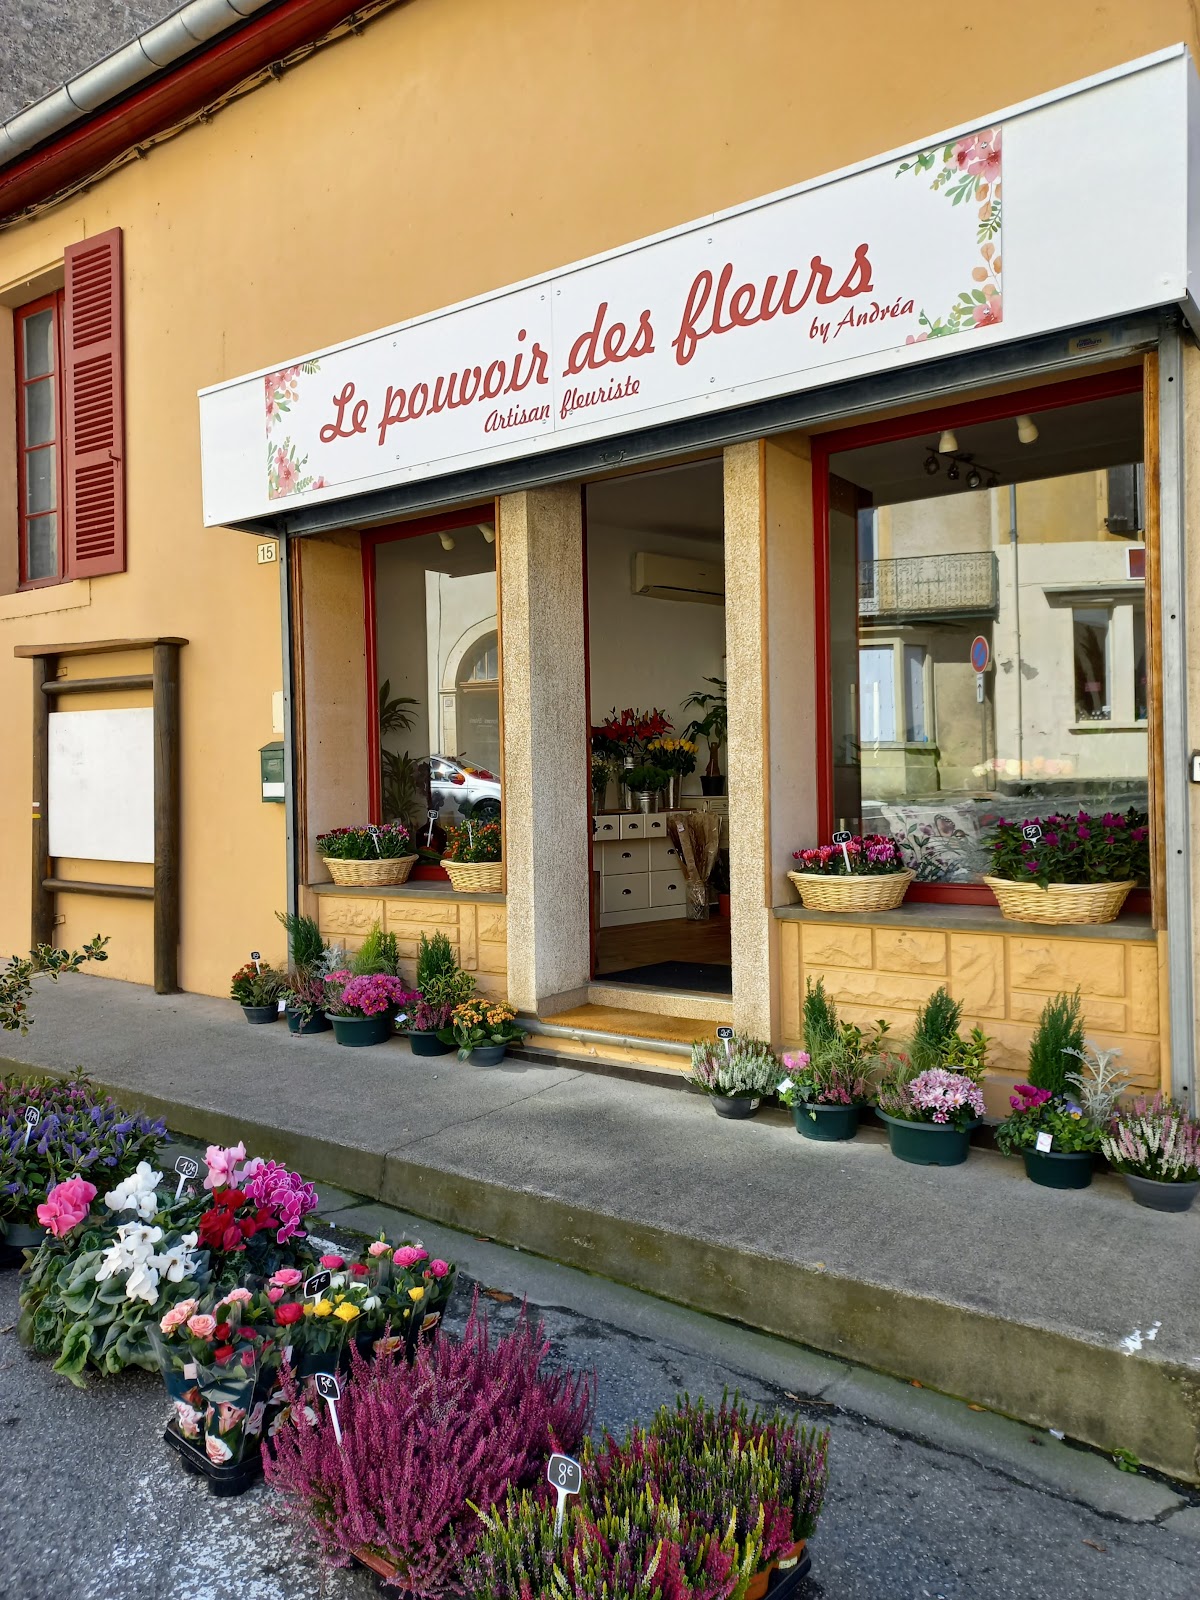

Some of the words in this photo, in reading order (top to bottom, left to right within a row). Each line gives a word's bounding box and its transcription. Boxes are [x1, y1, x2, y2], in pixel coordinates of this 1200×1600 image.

[809, 315, 832, 344] by
[834, 296, 916, 339] Andréa
[319, 382, 369, 444] Le
[378, 328, 549, 446] pouvoir
[562, 301, 656, 377] des
[671, 243, 874, 367] fleurs
[484, 403, 551, 433] Artisan
[559, 374, 641, 420] fleuriste
[259, 545, 274, 561] 15
[836, 832, 848, 843] 4€
[1026, 826, 1038, 838] 5€
[310, 1274, 326, 1291] 7€
[320, 1376, 332, 1393] 5€
[558, 1462, 574, 1485] 8€
